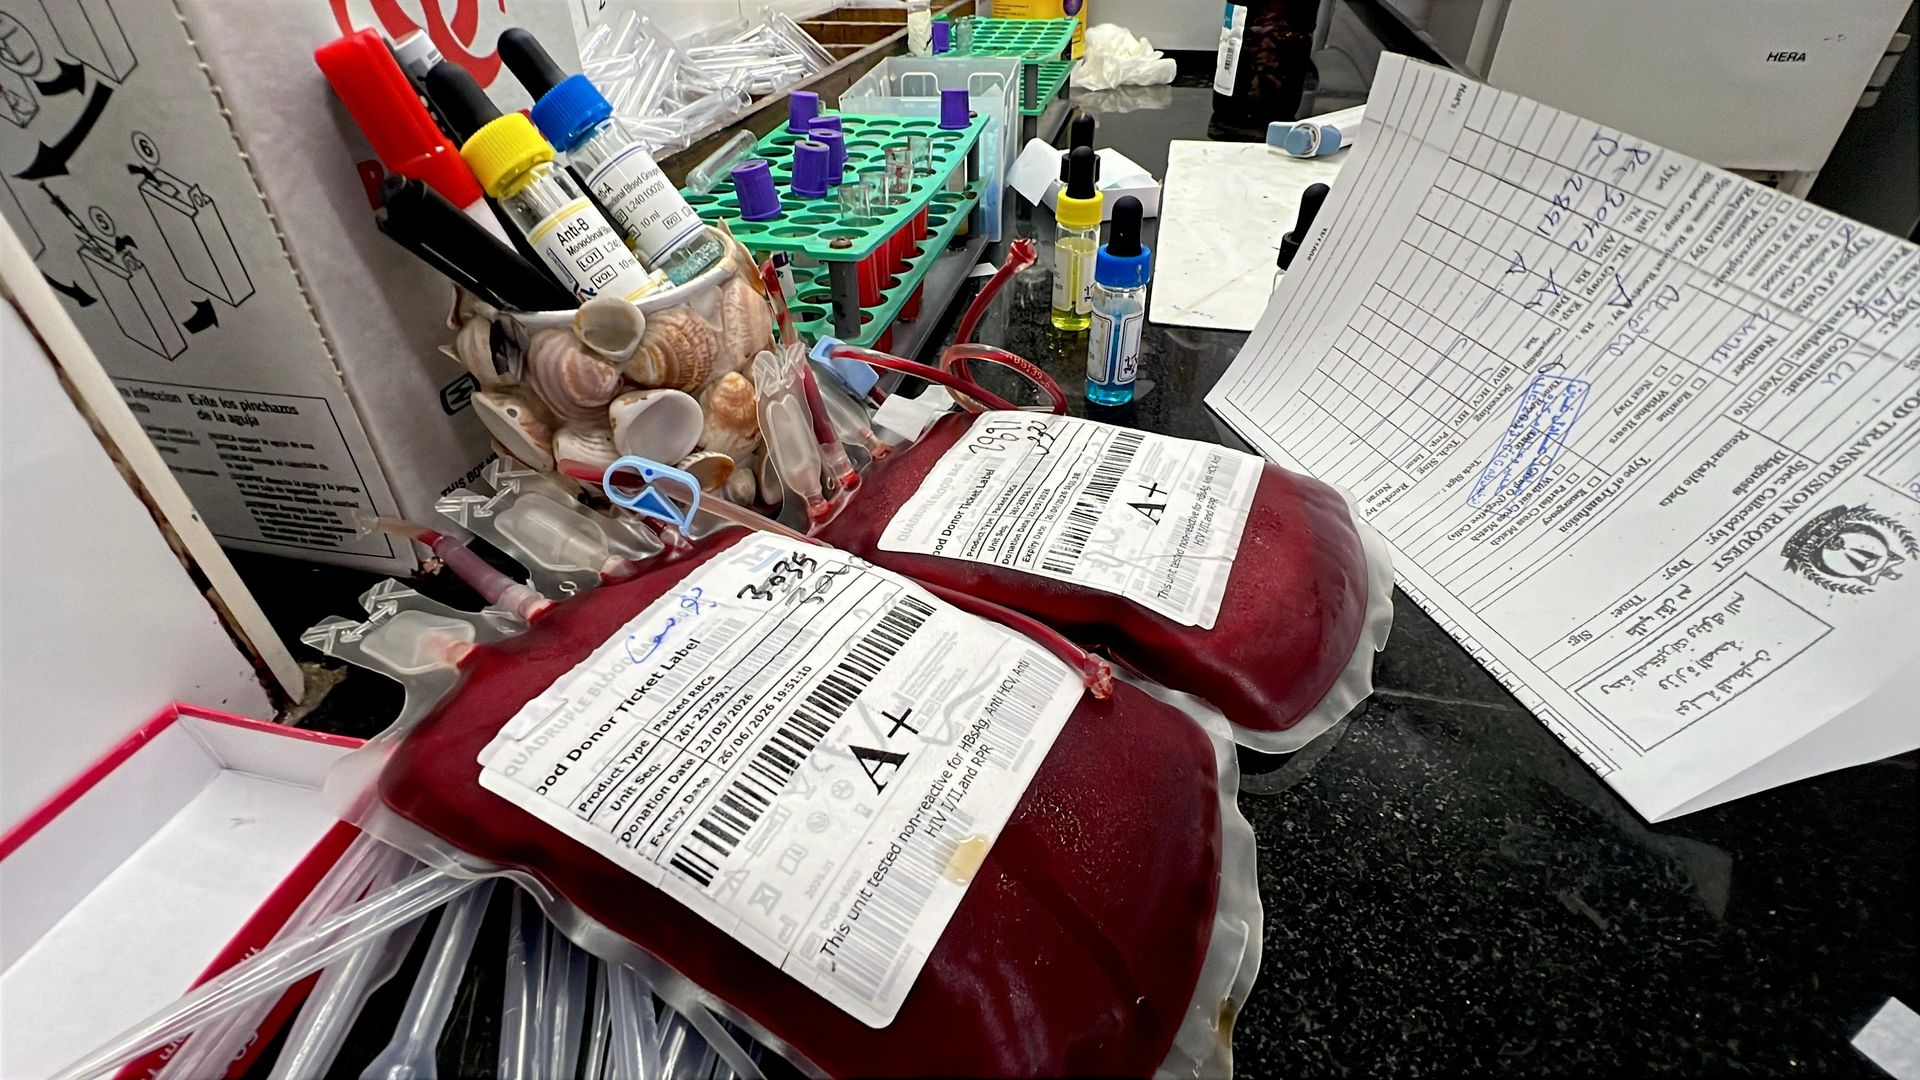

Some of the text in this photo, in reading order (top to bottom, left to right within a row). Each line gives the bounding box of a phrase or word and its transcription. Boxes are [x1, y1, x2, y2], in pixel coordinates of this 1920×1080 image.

[1766, 51, 1806, 62] HERA
[140, 139, 153, 157] 6
[622, 175, 643, 193] Blood
[1656, 165, 1681, 190] Type
[624, 181, 663, 213] L24010020
[1537, 176, 1583, 236] 2891
[1622, 205, 1642, 223] No.
[1664, 171, 1714, 231] Blood Group
[96, 212, 109, 231] 5
[556, 217, 589, 246] Anti-B
[640, 209, 660, 228] 10 ml
[1568, 185, 1624, 252] 3042
[1634, 210, 1657, 233] Unit
[1689, 185, 1755, 260] Requested By
[1722, 208, 1758, 248] Platelets
[565, 229, 603, 256] Monoclonal
[579, 251, 598, 269] LOT
[1653, 234, 1686, 271] Request
[1746, 242, 1781, 276] Plasma
[594, 270, 611, 283] VOL
[1574, 268, 1590, 283] Rh
[1586, 244, 1632, 295] BL. Group
[1760, 263, 1790, 291] blood
[1779, 239, 1839, 298] Packed Cells
[1789, 237, 1875, 312] Types Units
[1855, 245, 1912, 300] Previous
[1548, 293, 1570, 316] Date
[1559, 300, 1582, 321] Exp.
[1522, 327, 1561, 369] Compatibility
[1732, 334, 1777, 376] Number
[1781, 337, 1849, 396] Consultant:
[1493, 365, 1510, 384] HBV
[187, 393, 299, 415] Evite los pinchazos
[1472, 387, 1490, 407] HCV
[1472, 383, 1513, 422] Screening
[1608, 379, 1653, 416] Next Day
[1655, 390, 1692, 421] Routine
[1732, 400, 1754, 415] No
[197, 409, 259, 427] de la aguja
[1454, 409, 1469, 426] HIV
[1608, 419, 1637, 443] Hours
[1416, 439, 1460, 474] Tech. Sing
[1428, 431, 1449, 447] Prep.
[1405, 453, 1424, 469] Issue
[1445, 457, 1481, 488] Tech Sign
[1658, 429, 1749, 506] Remarkable Data
[1732, 450, 1789, 495] Diagnosis
[941, 468, 995, 536] Donor Ticket Label
[1126, 482, 1167, 525] A+
[1365, 482, 1392, 503] Nurse
[1365, 482, 1409, 516] Receive by
[1470, 477, 1553, 541] With out Cross Match
[1542, 488, 1588, 525] Emergency
[1558, 456, 1651, 532] Type of Transfusion
[1699, 459, 1808, 544] Spec. Collected by:
[1711, 420, 1896, 572] TRANSFUSION REQUEST
[1447, 494, 1506, 540] (Negative Cells)
[1489, 484, 1566, 545] Partial Cross Match
[966, 517, 994, 556] Product Type
[987, 537, 1000, 551] Unit
[1001, 519, 1030, 564] Donation Date
[1021, 525, 1046, 562] Expiry Date
[1156, 501, 1201, 599] This non-reactive for
[1192, 532, 1205, 546] HIV
[736, 551, 817, 603] 3035
[1655, 558, 1693, 580] Day:
[1610, 594, 1646, 617] Time:
[1625, 583, 1691, 636] طلب نقل دم
[1567, 629, 1593, 646] Sig:
[1600, 591, 1744, 694] وحدة المختبرات وبنوك الدم
[1658, 640, 1742, 689] وزارة الصحة
[566, 716, 616, 761] Donor
[615, 672, 664, 712] Ticket
[660, 638, 700, 670] Label
[652, 676, 714, 731] Packed RBCs
[717, 665, 811, 764] 26/06/2026 19:51:10
[695, 693, 753, 753] 23/05/2026
[848, 707, 918, 795] A+
[577, 740, 649, 812] Product Type
[609, 763, 660, 811] Unit Seq.
[682, 777, 709, 804] Date
[923, 809, 946, 837] HIV
[940, 765, 977, 812] I/II,and
[970, 743, 993, 767] RPR
[617, 758, 695, 846] Donation Date
[819, 923, 850, 956] This
[847, 887, 873, 920] unit
[866, 841, 901, 887] tested
[898, 770, 952, 842] non-reactive
[946, 752, 963, 769] for
[958, 718, 991, 752] HBsAg,
[984, 694, 1003, 716] Anti
[996, 675, 1020, 696] HCV,
[1011, 658, 1029, 676] Anti
